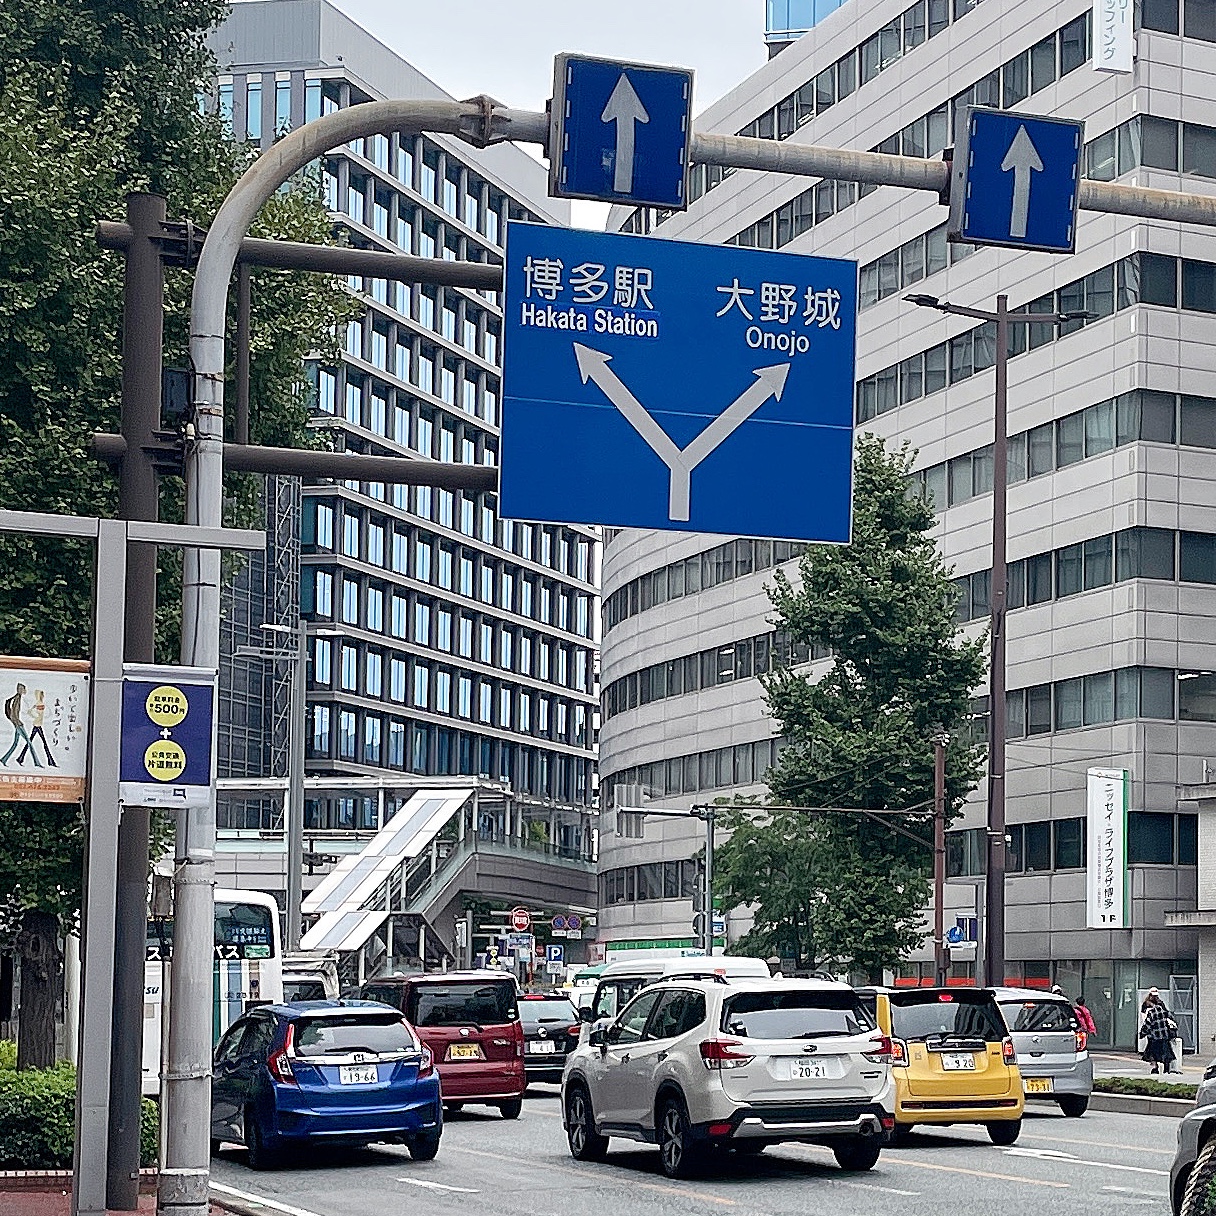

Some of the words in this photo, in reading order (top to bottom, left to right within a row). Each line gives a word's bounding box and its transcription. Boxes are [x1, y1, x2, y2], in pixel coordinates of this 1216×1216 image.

[523, 256, 654, 310] 博多駅
[521, 303, 588, 331] Hakata
[594, 309, 658, 338] Station
[715, 278, 842, 330] 大野城
[745, 326, 811, 357] Onojo
[1100, 914, 1117, 923] 1F
